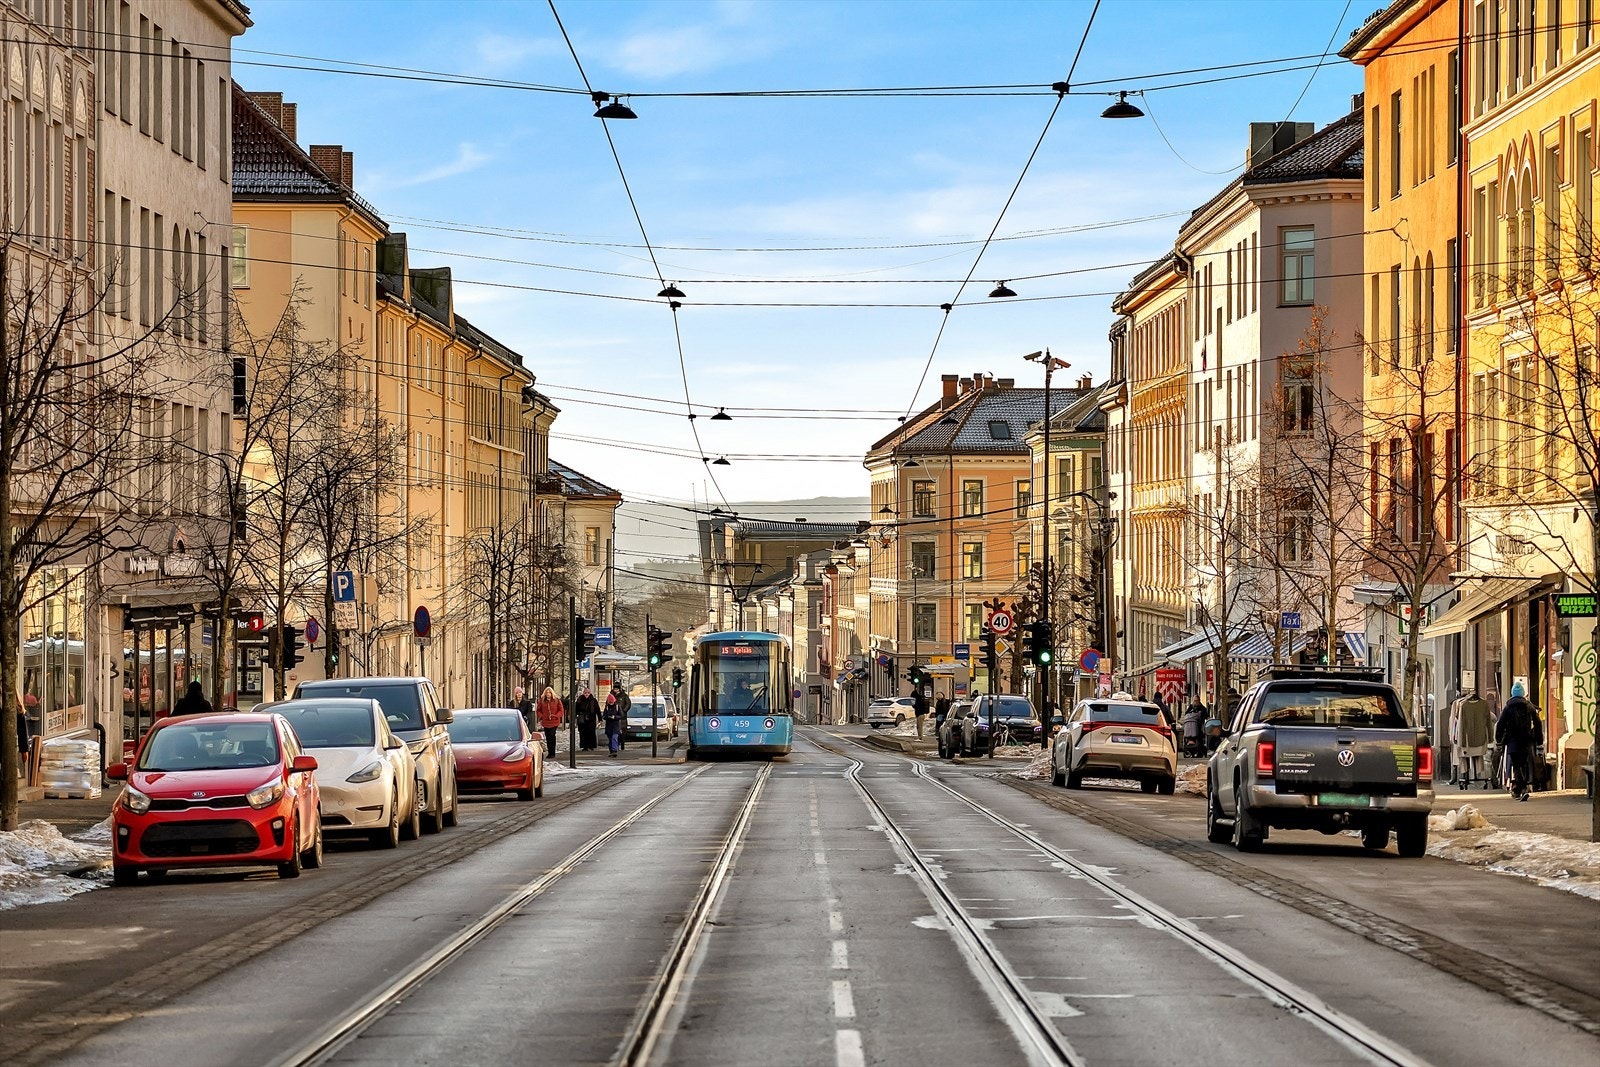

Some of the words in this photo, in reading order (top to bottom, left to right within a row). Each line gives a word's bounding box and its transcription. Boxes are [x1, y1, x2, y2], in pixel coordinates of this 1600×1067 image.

[337, 575, 349, 598] P
[1558, 597, 1597, 605] JUNGEL
[1561, 605, 1594, 613] PIZZA
[994, 616, 1009, 628] 40
[1283, 615, 1300, 625] Taxi
[734, 720, 750, 728] 459
